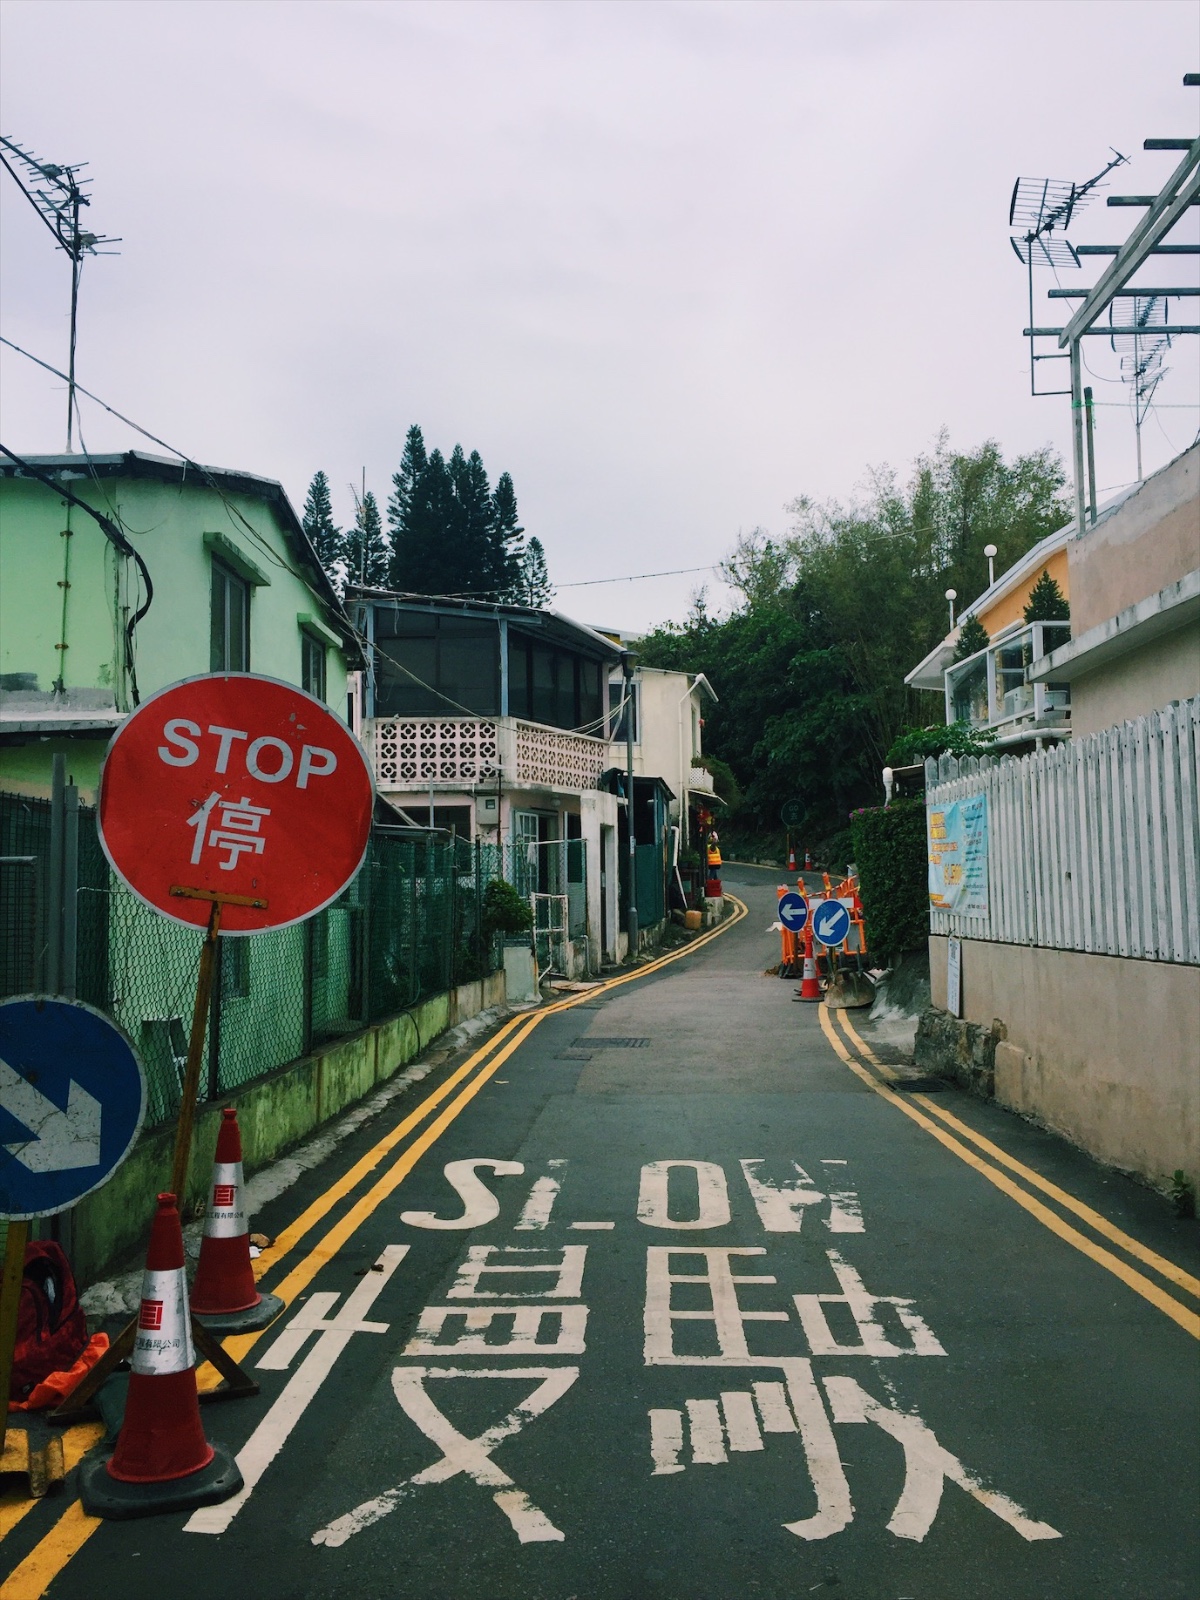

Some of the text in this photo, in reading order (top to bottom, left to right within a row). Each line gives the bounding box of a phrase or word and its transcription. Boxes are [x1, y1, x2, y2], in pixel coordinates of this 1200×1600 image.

[157, 718, 338, 790] STOP
[186, 791, 271, 871] 停
[400, 1158, 865, 1233] SLOW
[183, 1244, 1063, 1548] 慢駛
